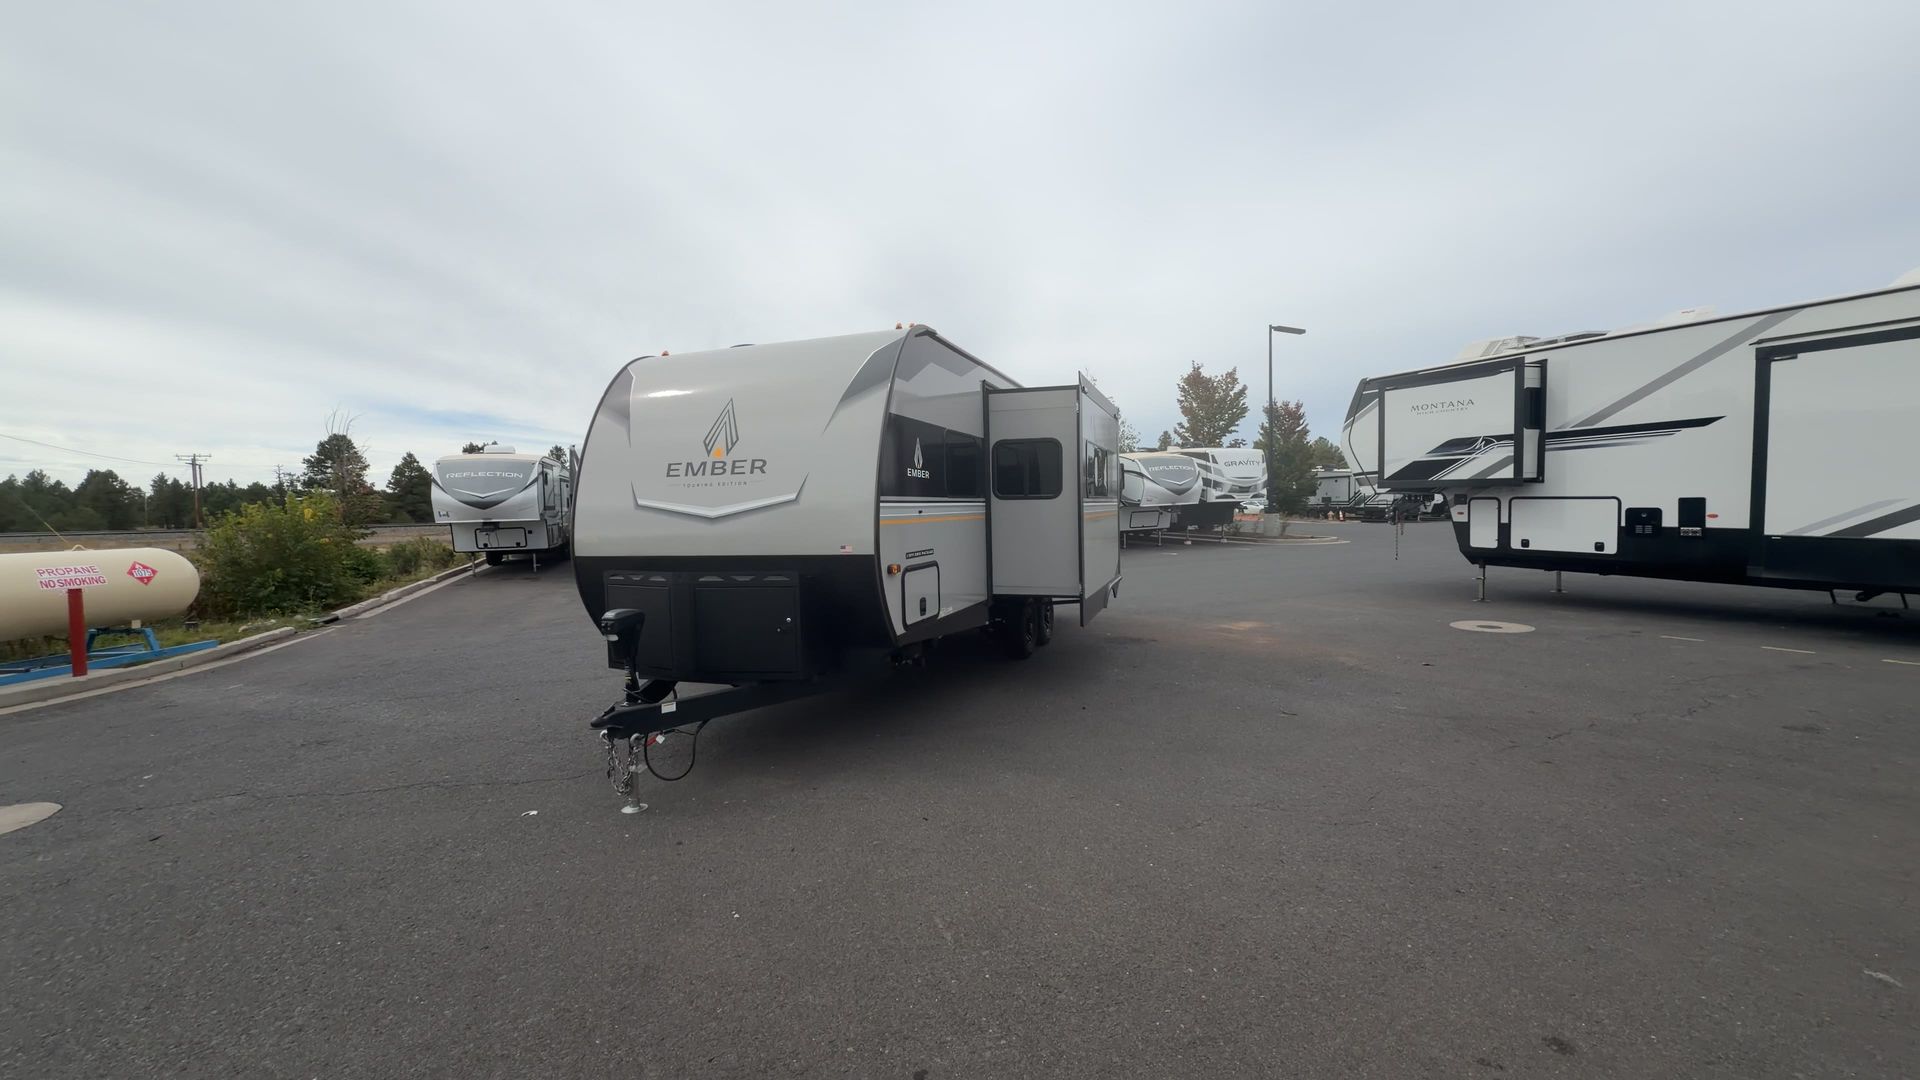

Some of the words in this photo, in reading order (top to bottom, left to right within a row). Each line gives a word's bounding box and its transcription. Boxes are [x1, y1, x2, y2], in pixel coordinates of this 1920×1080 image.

[1410, 399, 1474, 412] MONTANA
[666, 458, 768, 478] EMBER
[1223, 459, 1260, 467] GRAVITY
[446, 471, 523, 479] REFLECTION
[907, 467, 930, 479] EMBER
[36, 565, 100, 576] PROPANE
[40, 579, 56, 589] NO
[57, 575, 106, 588] SMOKING
